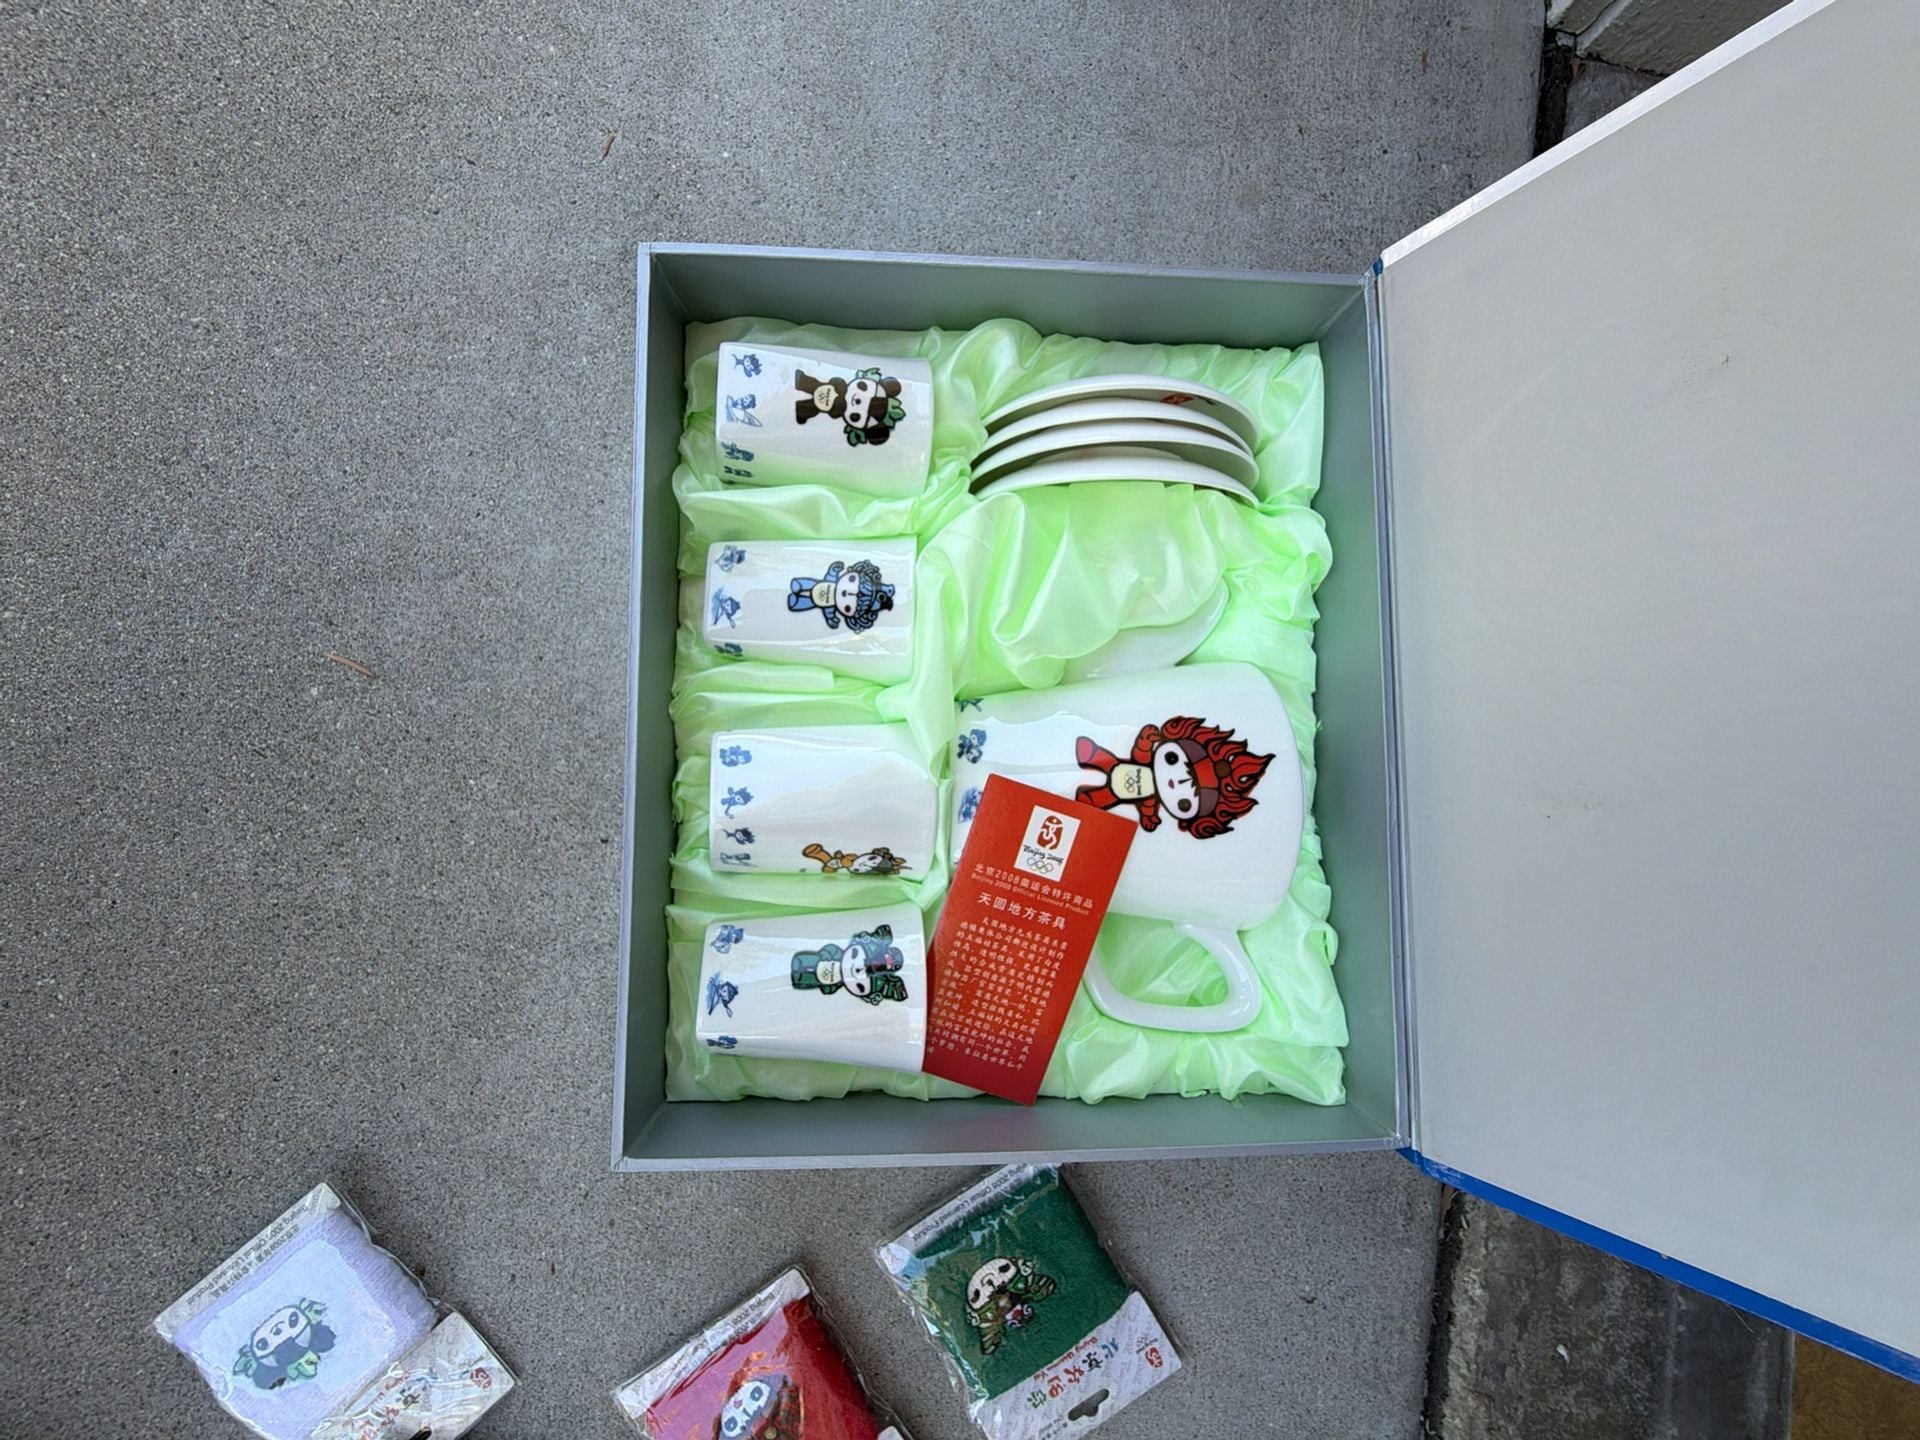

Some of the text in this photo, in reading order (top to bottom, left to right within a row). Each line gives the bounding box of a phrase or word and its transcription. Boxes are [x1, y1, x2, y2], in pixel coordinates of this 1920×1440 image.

[1021, 844, 1047, 860] Beijing
[970, 872, 993, 885] Beijing
[994, 880, 1011, 890] 2008
[1012, 886, 1036, 898] Official
[1064, 903, 1089, 915] Product
[990, 1173, 1009, 1189] 2008
[938, 1199, 970, 1223] Licensed
[910, 1219, 940, 1242] Product
[1023, 1336, 1124, 1412] 北京欢迎你
